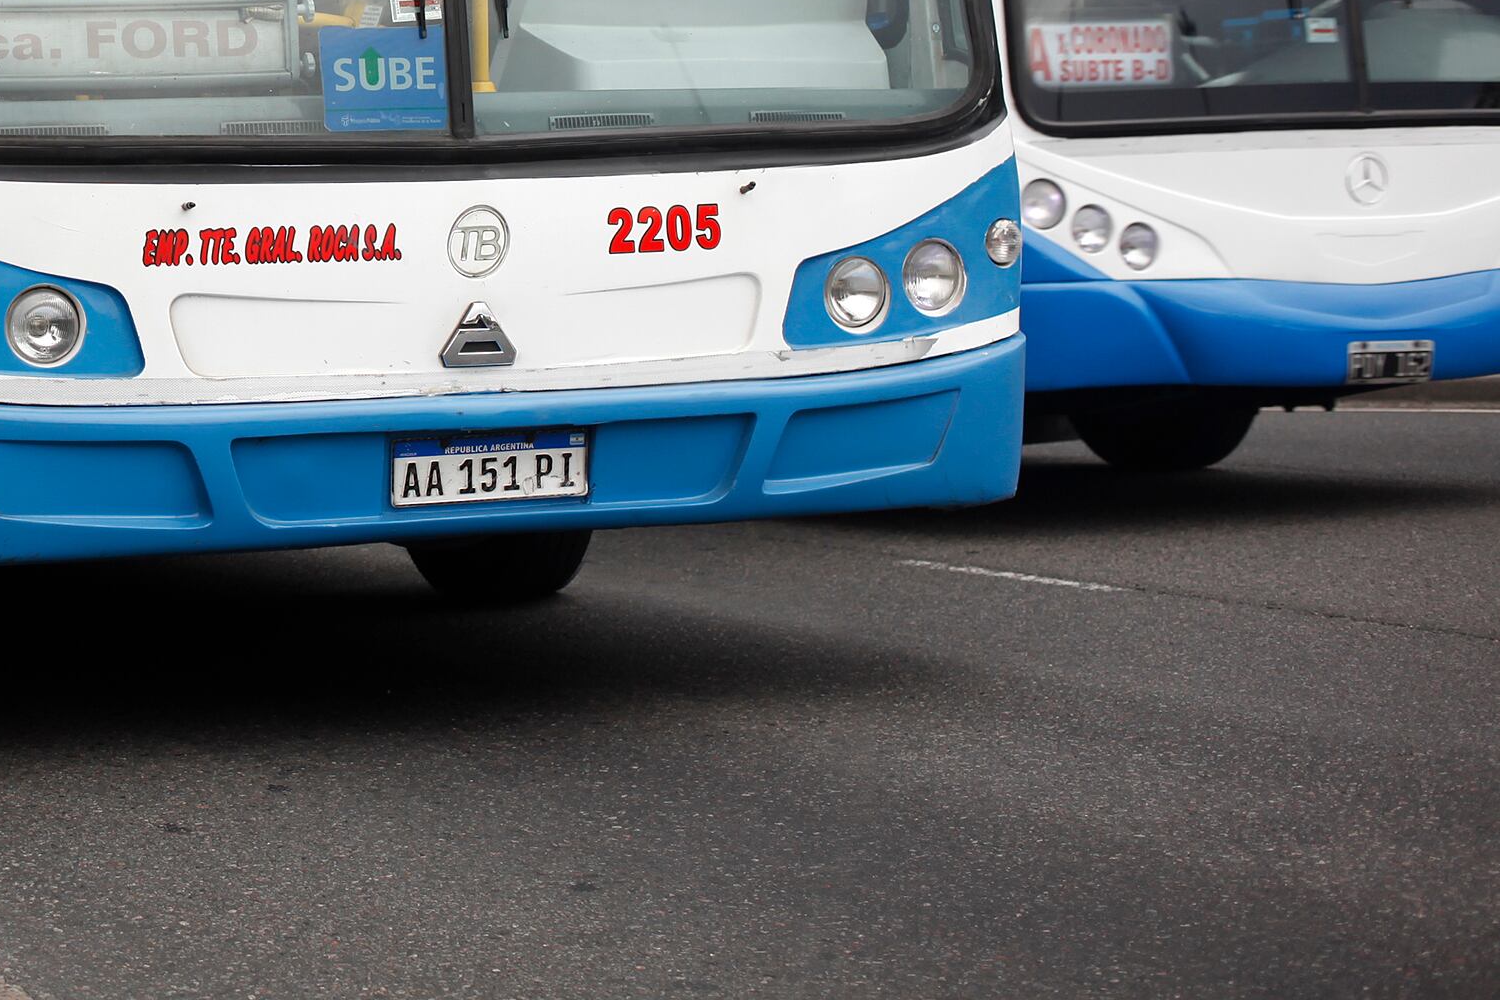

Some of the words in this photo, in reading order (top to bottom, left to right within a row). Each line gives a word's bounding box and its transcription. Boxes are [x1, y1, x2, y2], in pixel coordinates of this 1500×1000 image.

[85, 19, 259, 59] FORD
[1029, 27, 1053, 82] A
[333, 56, 437, 92] SUBE
[1059, 59, 1125, 83] SUBTE
[142, 228, 194, 267] EMP.
[199, 227, 241, 266] TTE.
[244, 225, 303, 264] GRAL.
[307, 223, 359, 263] ROCA
[362, 222, 402, 261] S.A.
[453, 225, 502, 262] TB
[607, 203, 721, 255] 2205
[444, 445, 489, 455] REPUBLICA
[490, 442, 535, 453] ARGENTINA
[402, 460, 444, 498] AA
[458, 455, 520, 495] 151
[534, 452, 576, 489] PI
